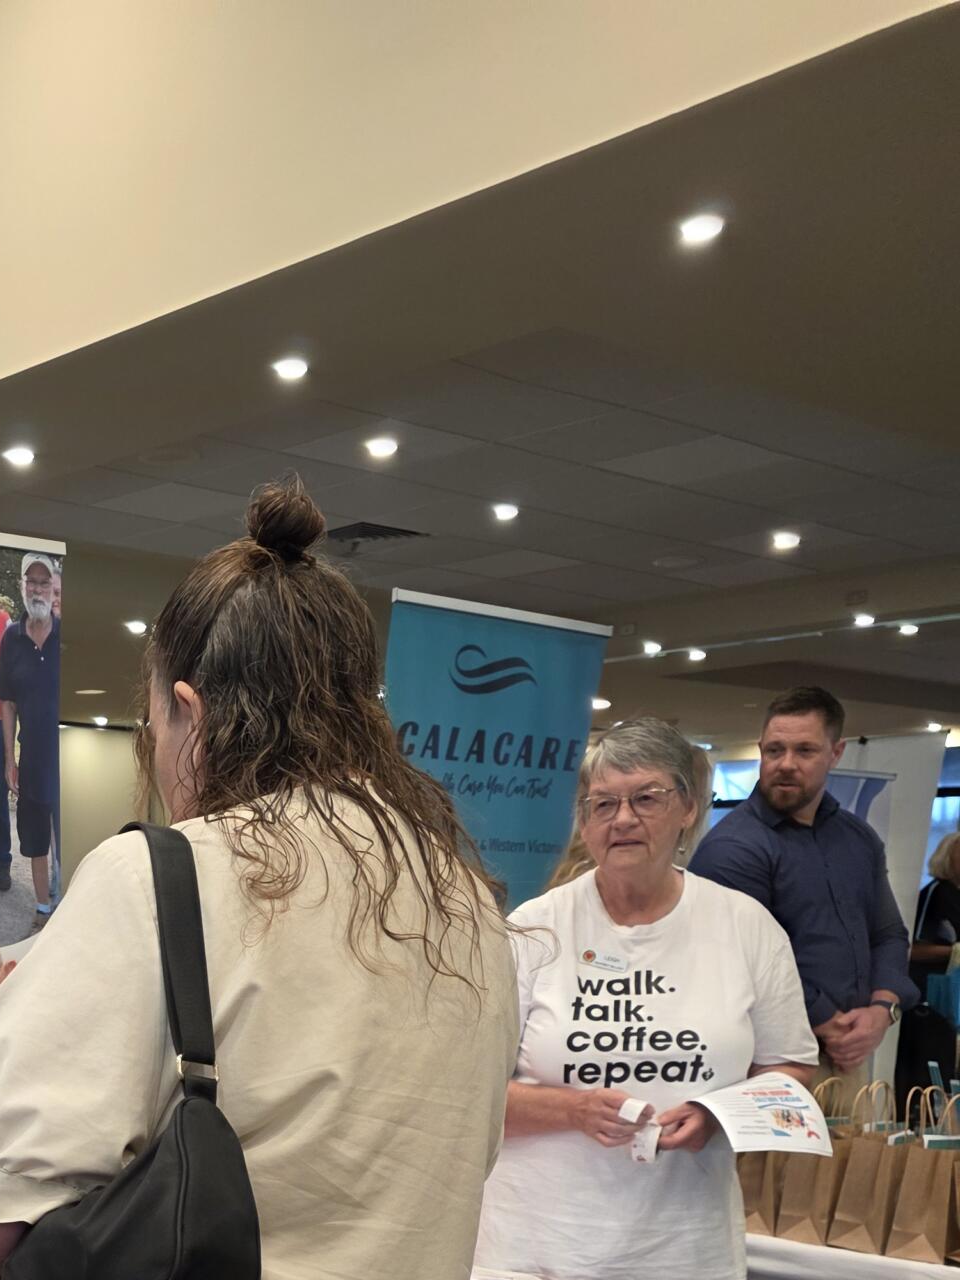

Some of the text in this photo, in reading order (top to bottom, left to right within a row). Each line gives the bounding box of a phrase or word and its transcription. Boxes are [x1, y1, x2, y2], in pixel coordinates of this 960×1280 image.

[397, 721, 581, 771] CALACARE
[577, 970, 676, 996] walk.
[572, 997, 654, 1022] talk.
[566, 1027, 707, 1052] coffee.
